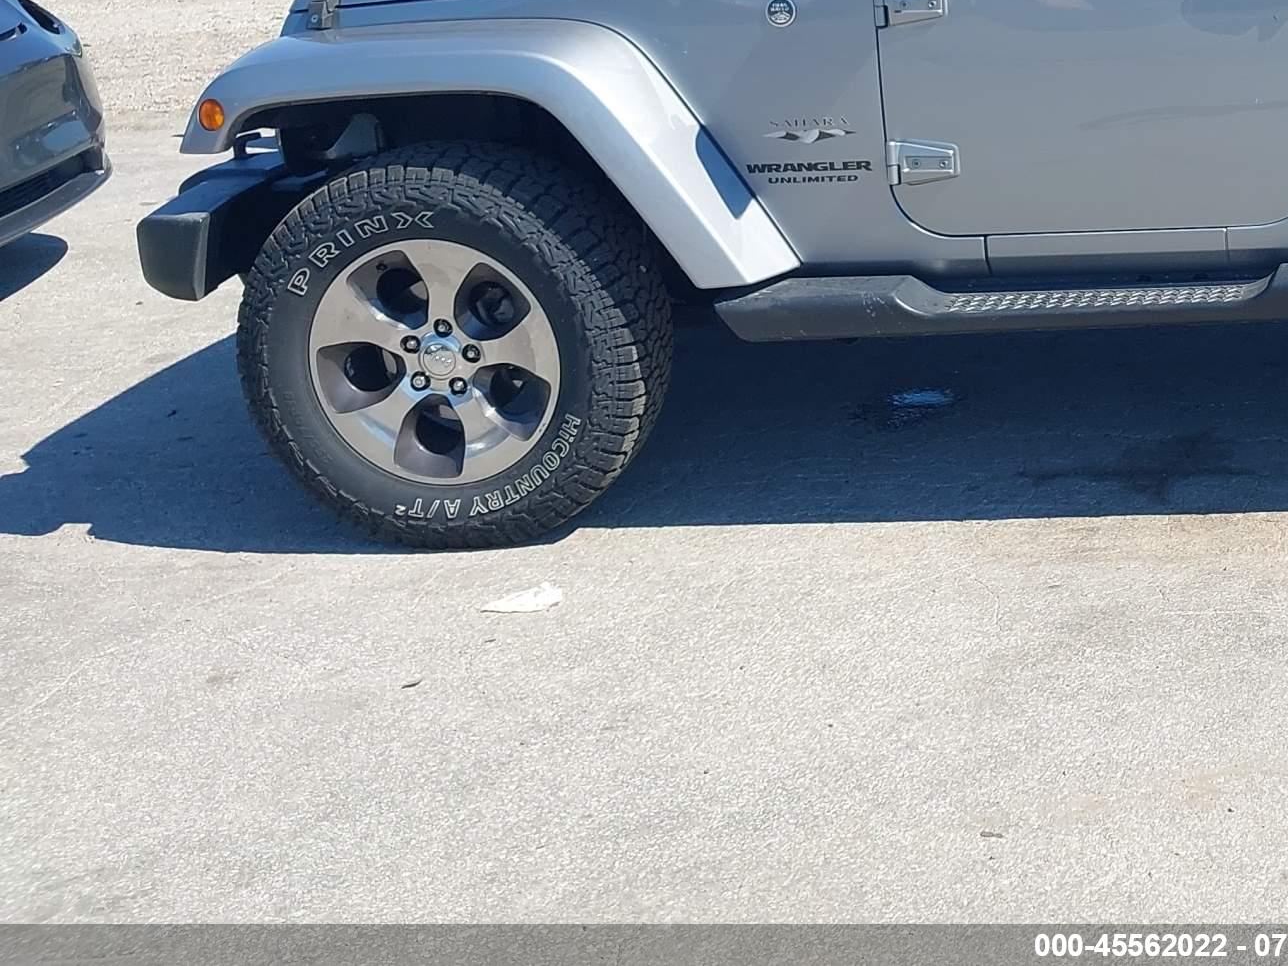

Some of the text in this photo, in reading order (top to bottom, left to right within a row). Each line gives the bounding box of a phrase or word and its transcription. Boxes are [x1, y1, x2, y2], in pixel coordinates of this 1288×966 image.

[769, 116, 851, 128] SAHARA
[746, 160, 873, 174] WRANGLER
[768, 175, 859, 185] UNLIMITED
[287, 211, 435, 296] PRINX
